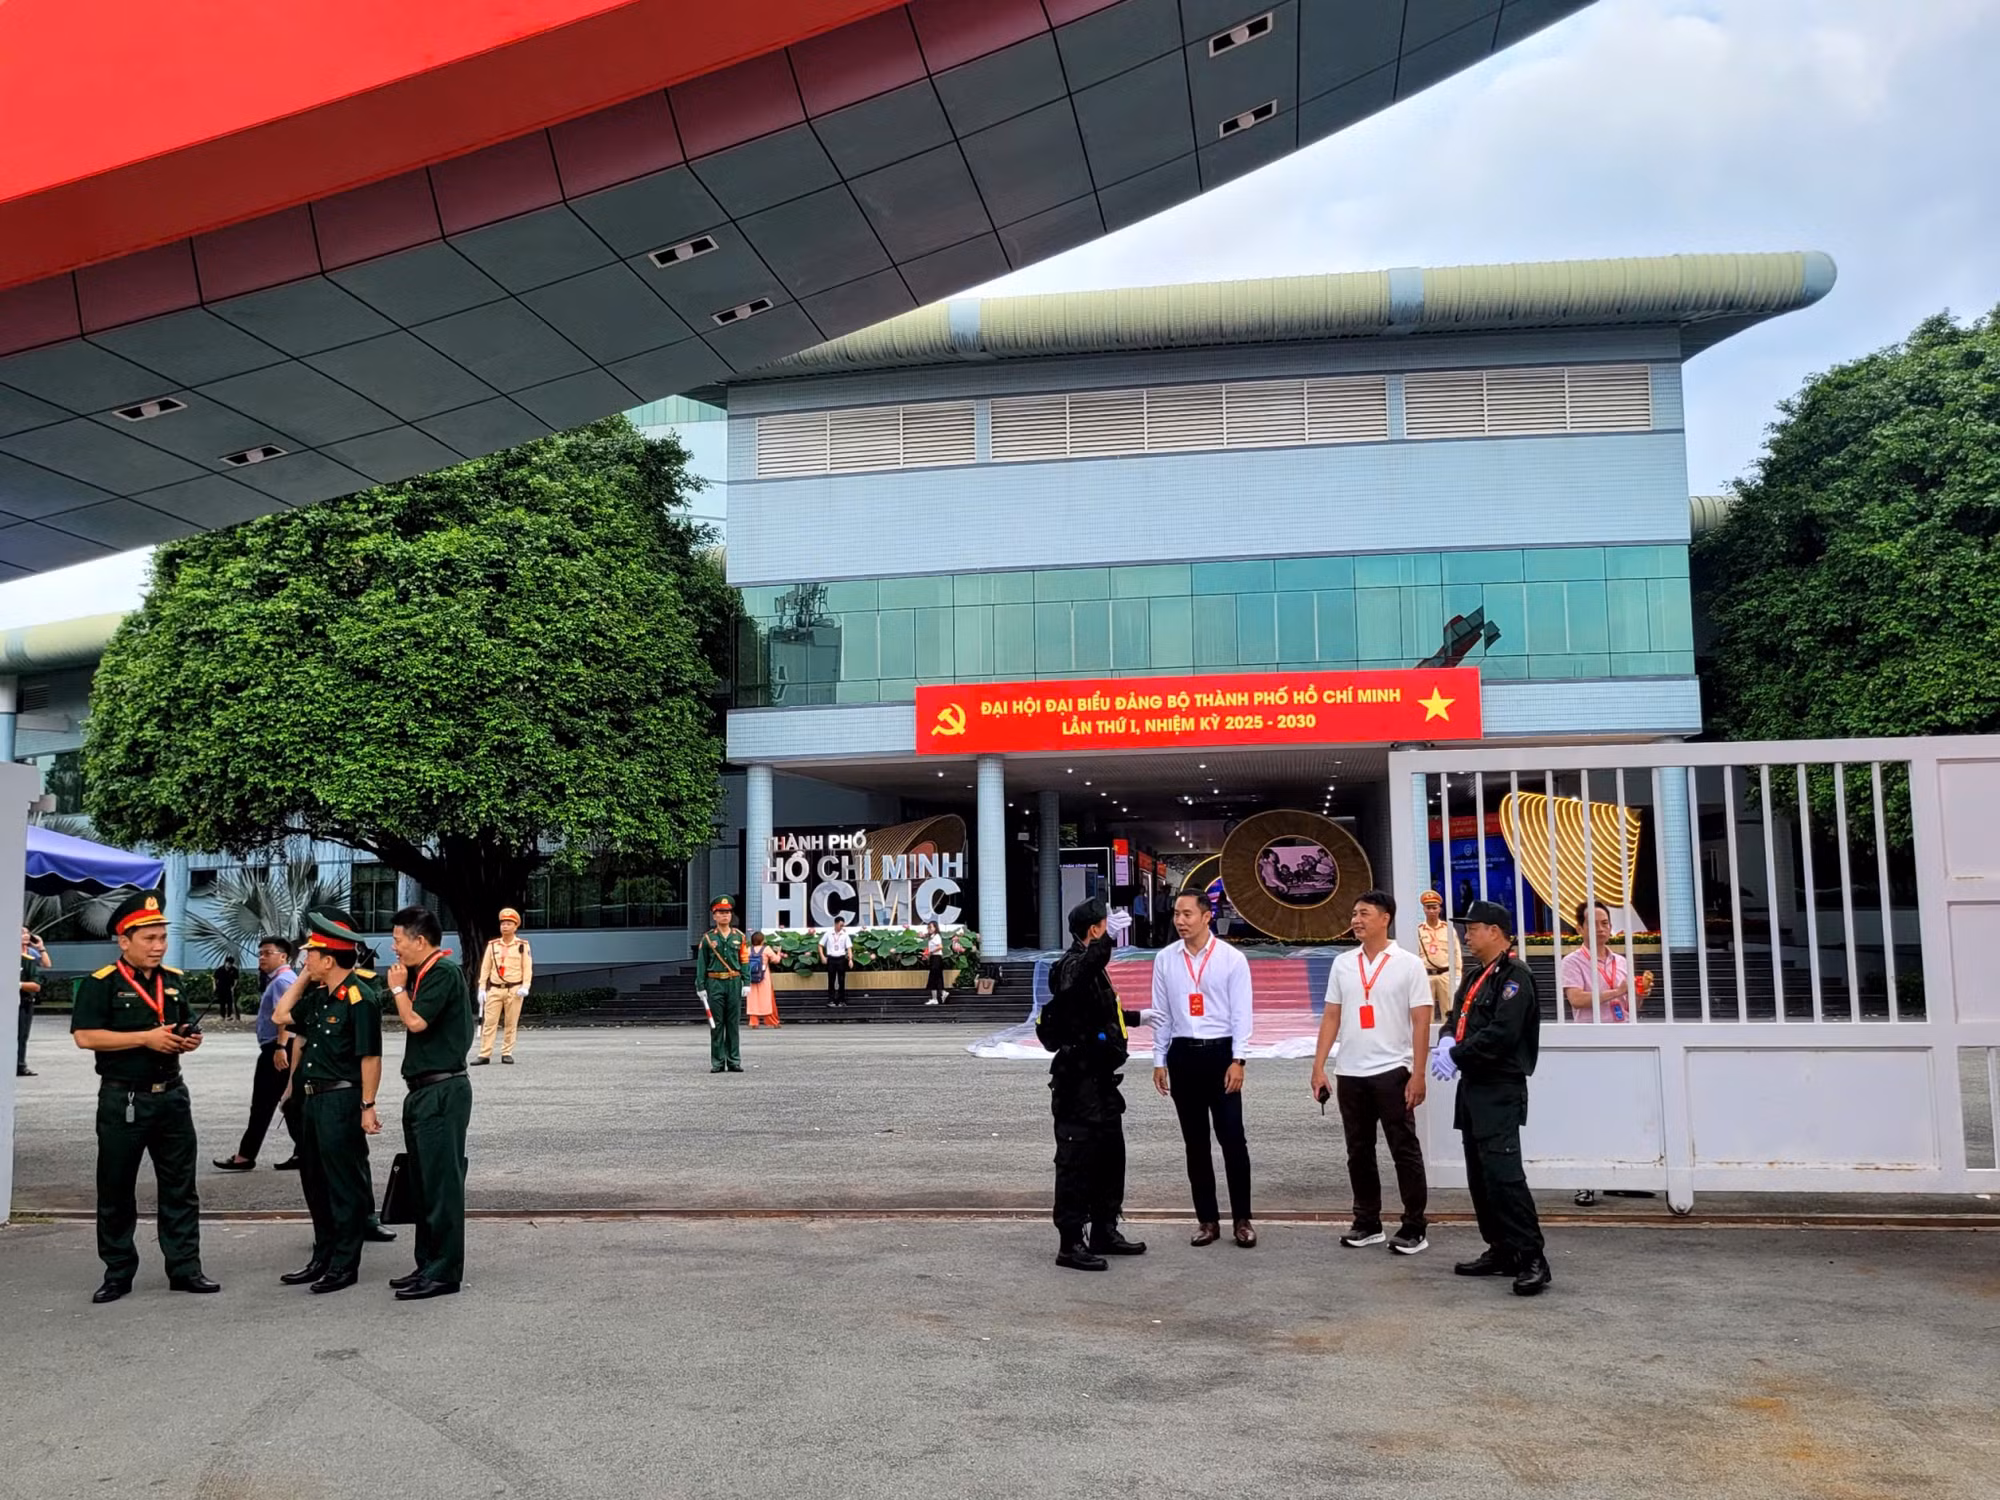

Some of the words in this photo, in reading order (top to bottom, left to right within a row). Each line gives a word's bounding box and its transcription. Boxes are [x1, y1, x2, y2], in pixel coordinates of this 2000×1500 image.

[981, 701, 1008, 718] ĐẠI
[1012, 697, 1040, 717] HỘI
[1045, 699, 1073, 716] ĐẠI
[1077, 691, 1110, 711] BIỂU
[1115, 692, 1163, 710] ĐẢNG
[1168, 691, 1190, 712] BỘ
[1194, 690, 1249, 707] THÀNH
[1254, 686, 1289, 706] PHỐ
[1293, 684, 1318, 704] HỒ
[1323, 686, 1353, 704] CHÍ
[1357, 688, 1401, 703] MINH
[1062, 715, 1092, 735] LẦN
[1096, 716, 1127, 734] THỨ
[1130, 719, 1140, 735] I,
[1145, 715, 1195, 735] NHIỆM
[1200, 713, 1220, 731] KỲ
[1225, 715, 1264, 730] 2025
[1277, 714, 1316, 729] 2030
[764, 833, 824, 850] THÀNH
[828, 829, 867, 849] PHỐ
[764, 851, 810, 882] HỒ
[817, 849, 872, 881] CHÍ
[882, 852, 964, 880] MINH
[761, 879, 962, 928] HCMC
